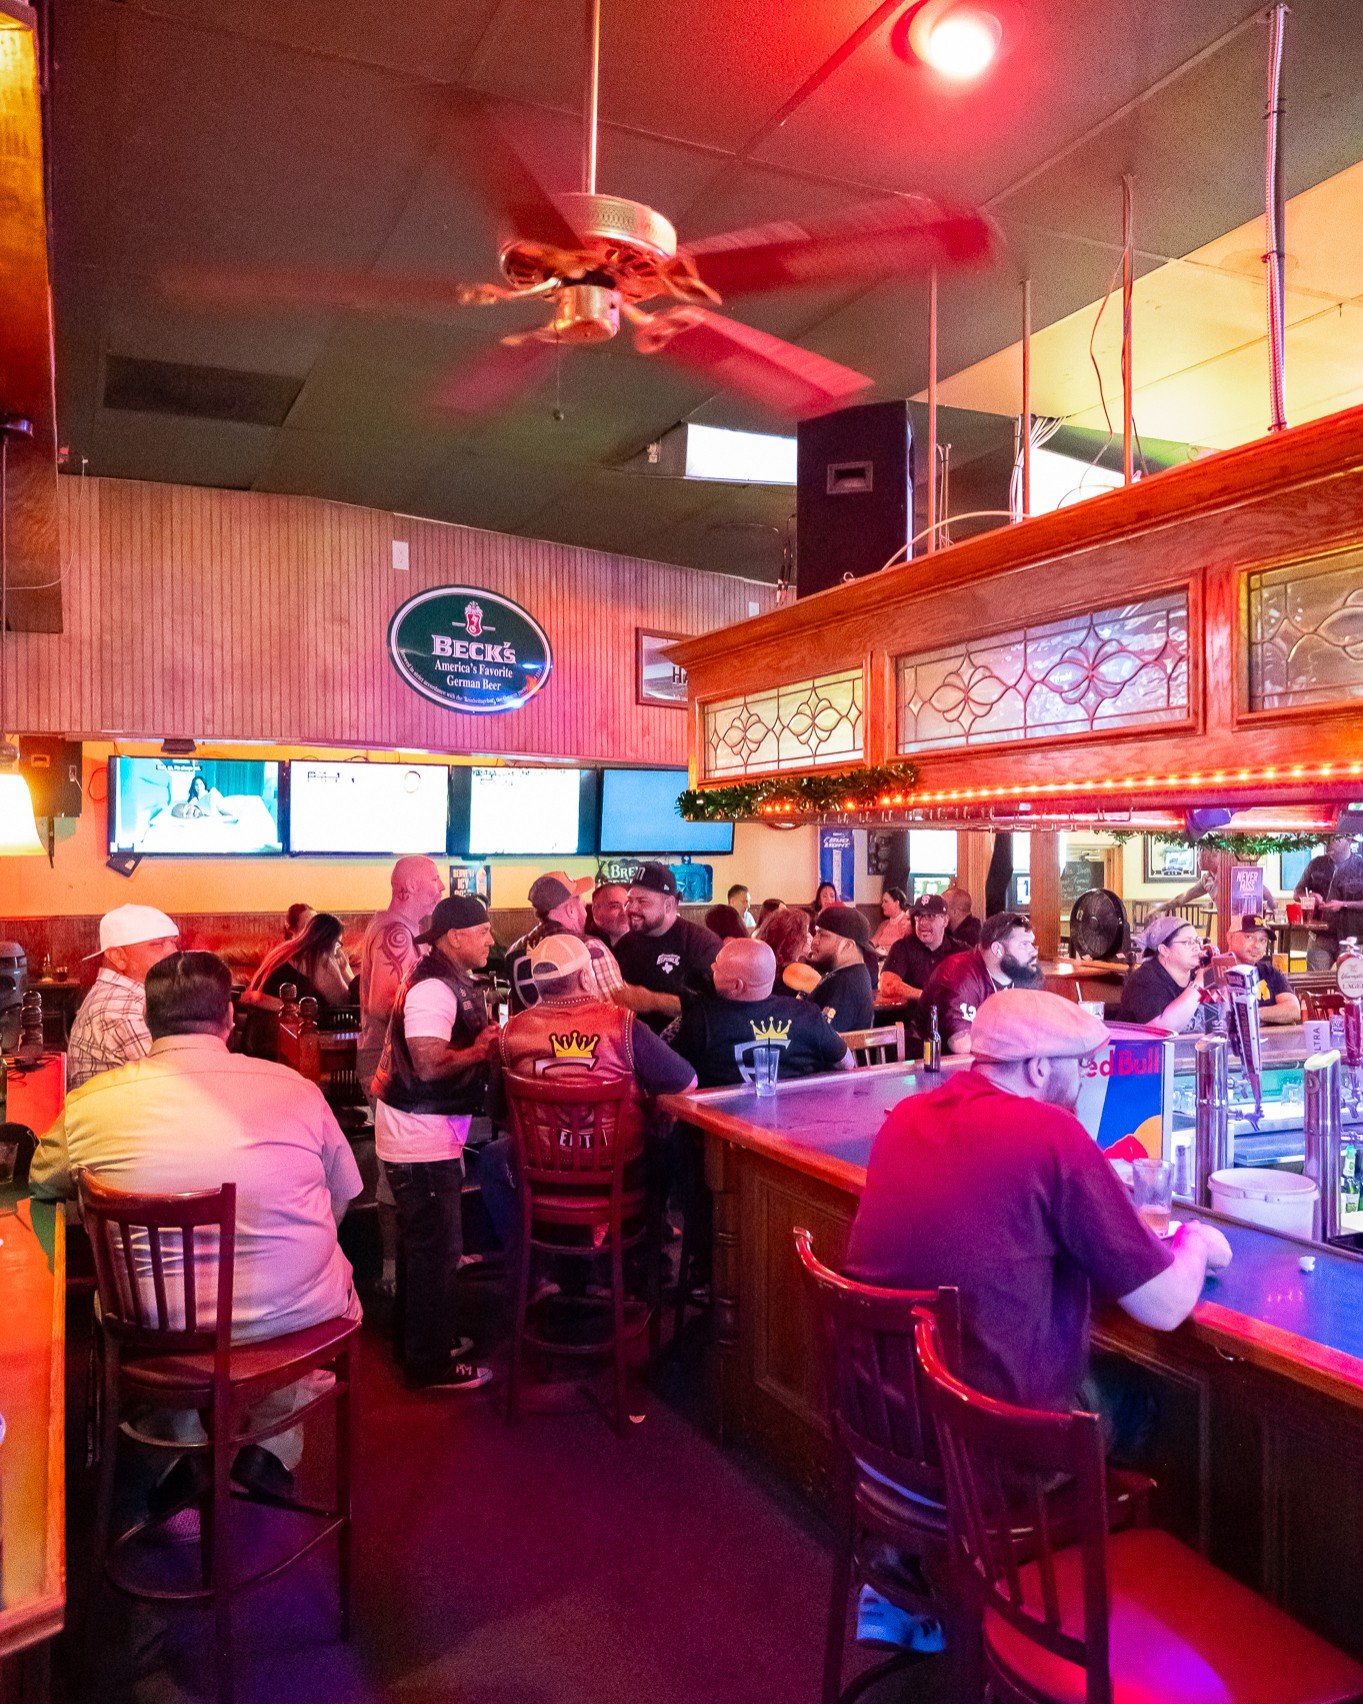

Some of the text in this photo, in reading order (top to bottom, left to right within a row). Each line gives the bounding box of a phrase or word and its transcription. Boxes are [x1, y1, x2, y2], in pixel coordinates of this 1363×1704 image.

[434, 659, 513, 679] America's Favorite
[446, 675, 502, 692] German Beer
[457, 878, 469, 890] ICY
[1237, 871, 1259, 882] NEVER
[1313, 1027, 1322, 1056] LTRA
[1086, 1046, 1160, 1078] ed Bull
